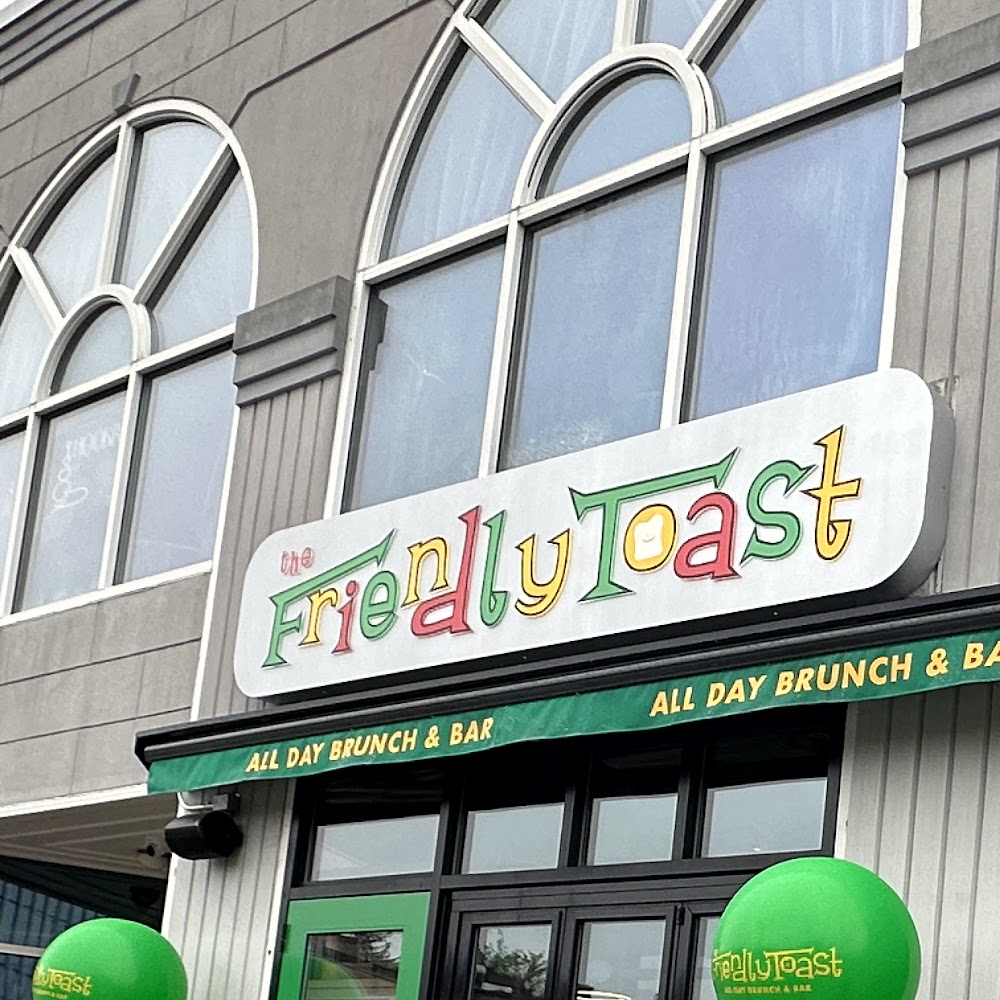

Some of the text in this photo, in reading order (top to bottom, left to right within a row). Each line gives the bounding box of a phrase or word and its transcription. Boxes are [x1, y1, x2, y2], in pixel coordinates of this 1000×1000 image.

[568, 424, 863, 603] Toast
[281, 549, 313, 577] the
[649, 690, 695, 718] ALL
[706, 674, 767, 708] DAY
[774, 652, 913, 697] BRUNCH
[925, 649, 950, 677] &
[245, 717, 495, 773] ALL DAY BRUNCH & BAR
